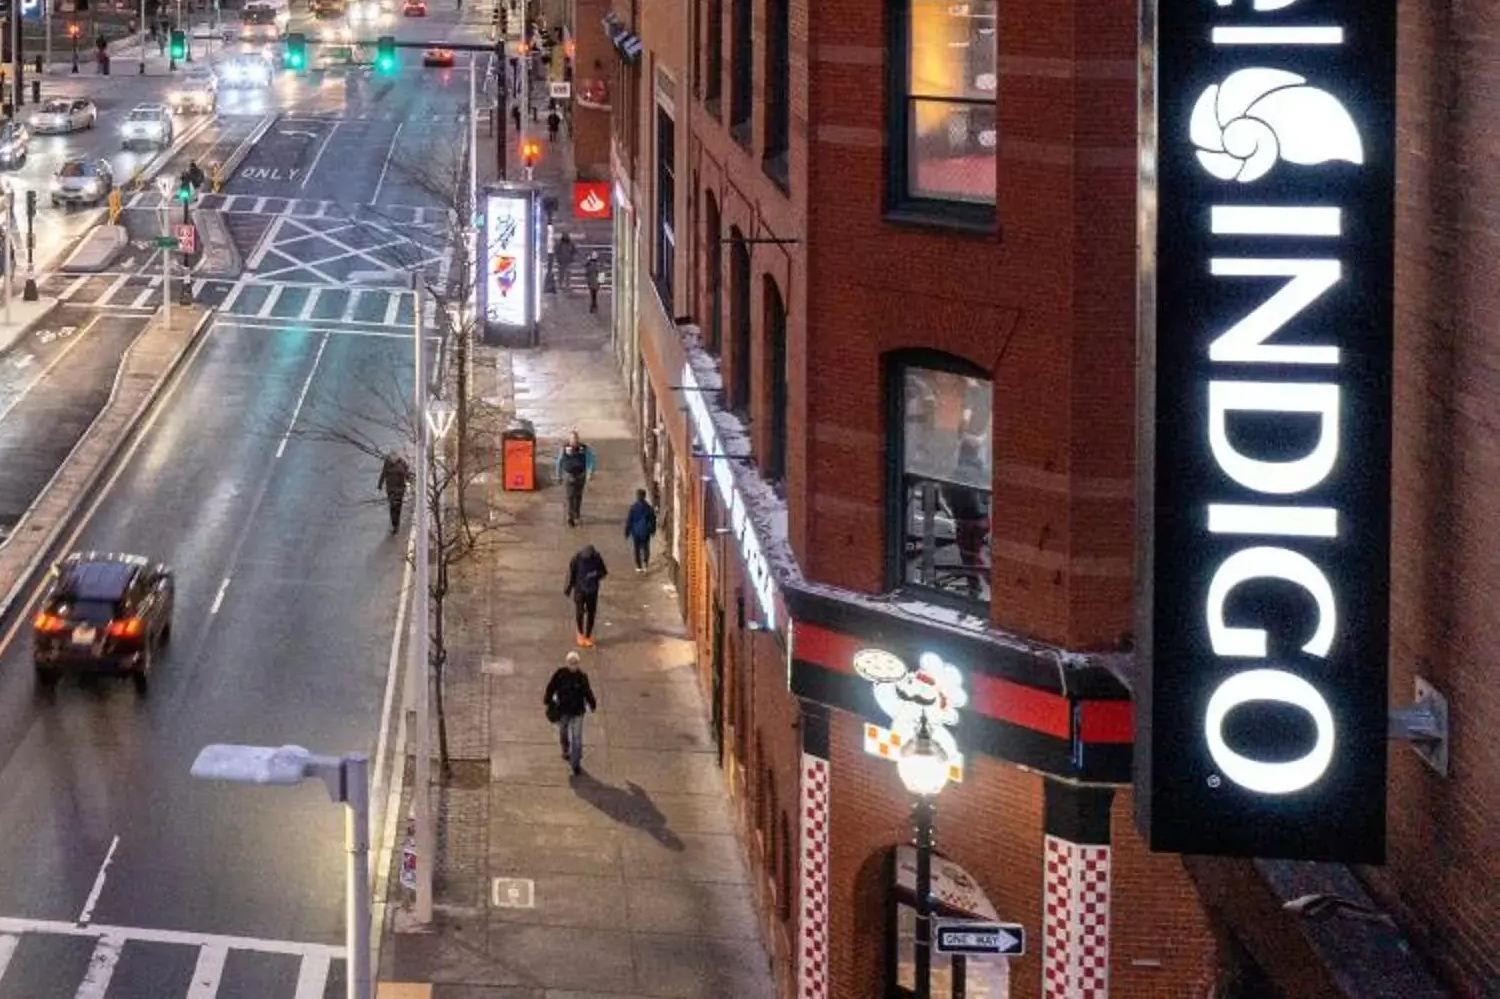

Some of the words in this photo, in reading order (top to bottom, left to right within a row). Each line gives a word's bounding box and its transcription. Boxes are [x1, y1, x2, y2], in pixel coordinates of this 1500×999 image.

[241, 168, 300, 181] ONLY
[1204, 204, 1343, 795] INDIGO
[946, 933, 969, 946] ONE
[974, 934, 998, 947] WAY
